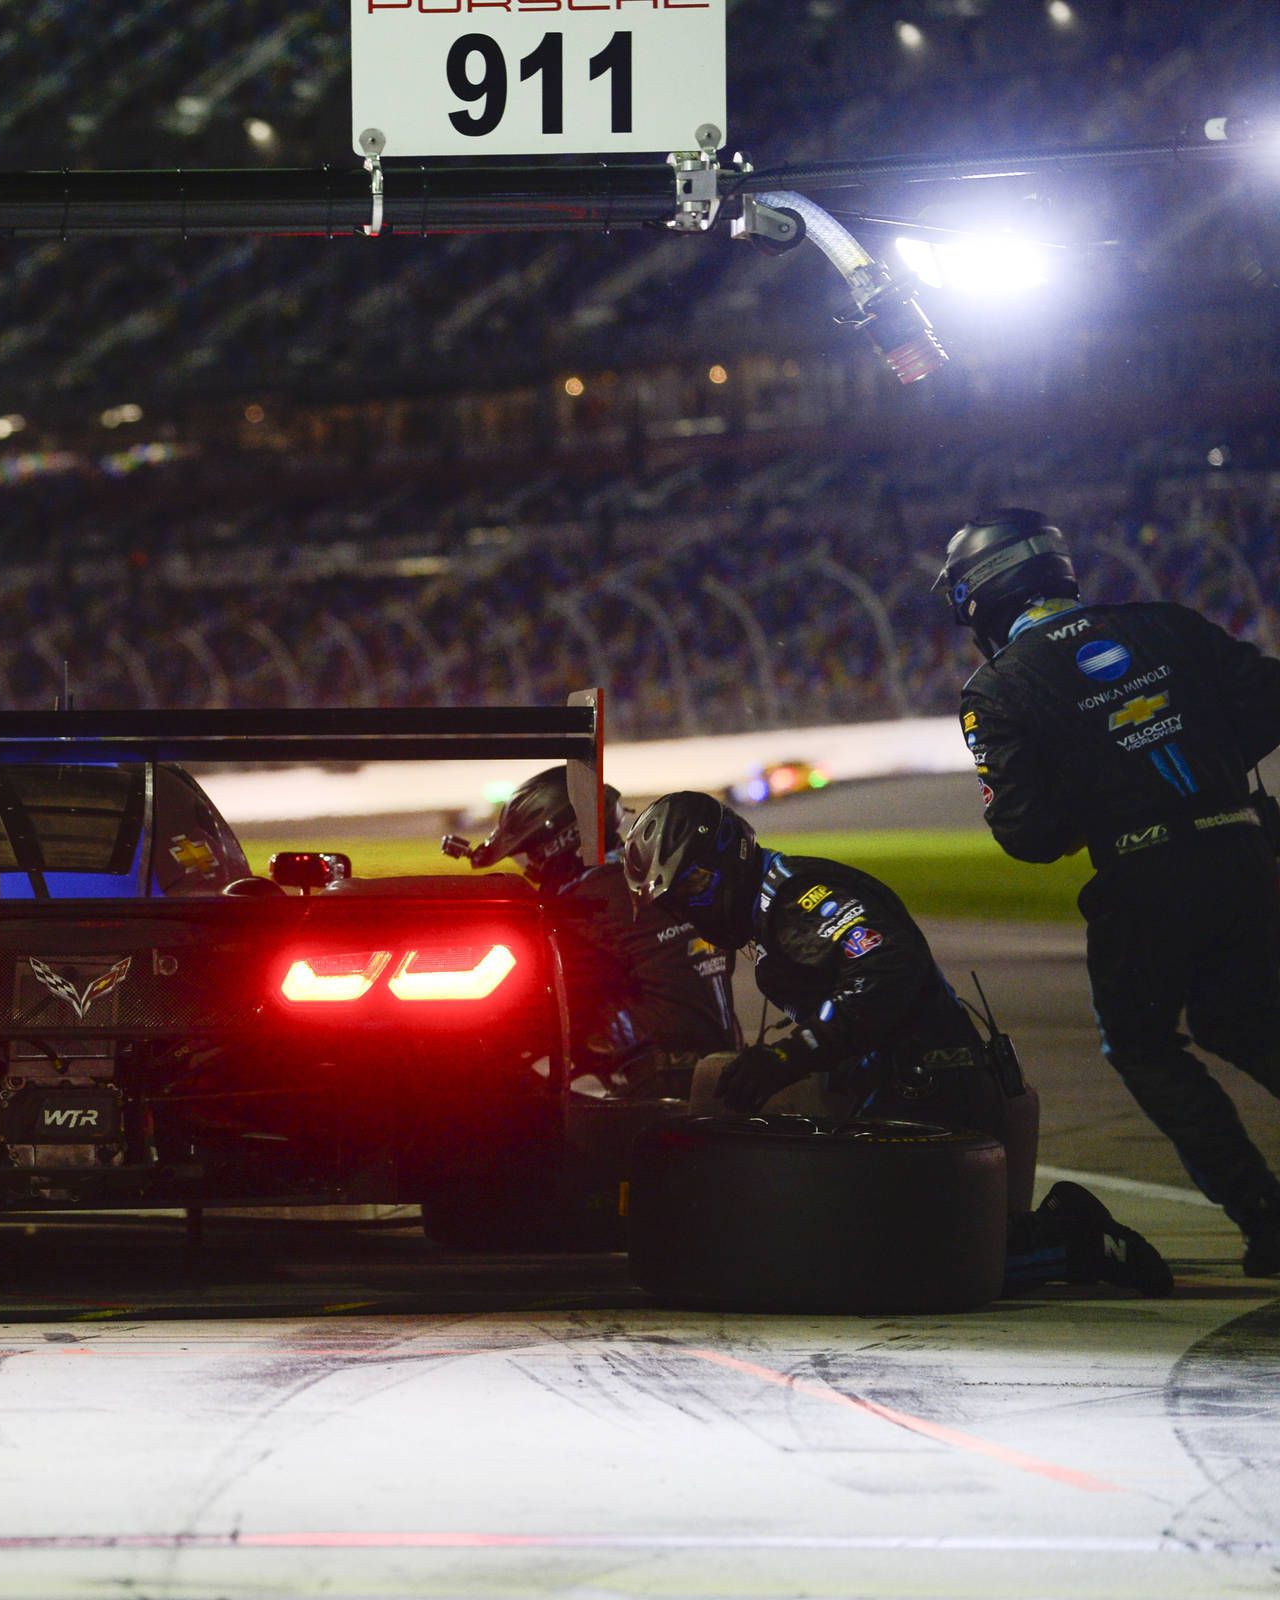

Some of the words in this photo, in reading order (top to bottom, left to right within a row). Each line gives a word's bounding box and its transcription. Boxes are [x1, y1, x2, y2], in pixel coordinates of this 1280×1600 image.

[446, 30, 633, 137] 911
[1045, 618, 1091, 641] WTR
[1116, 713, 1183, 749] VELOCITY
[44, 1109, 99, 1129] WTR
